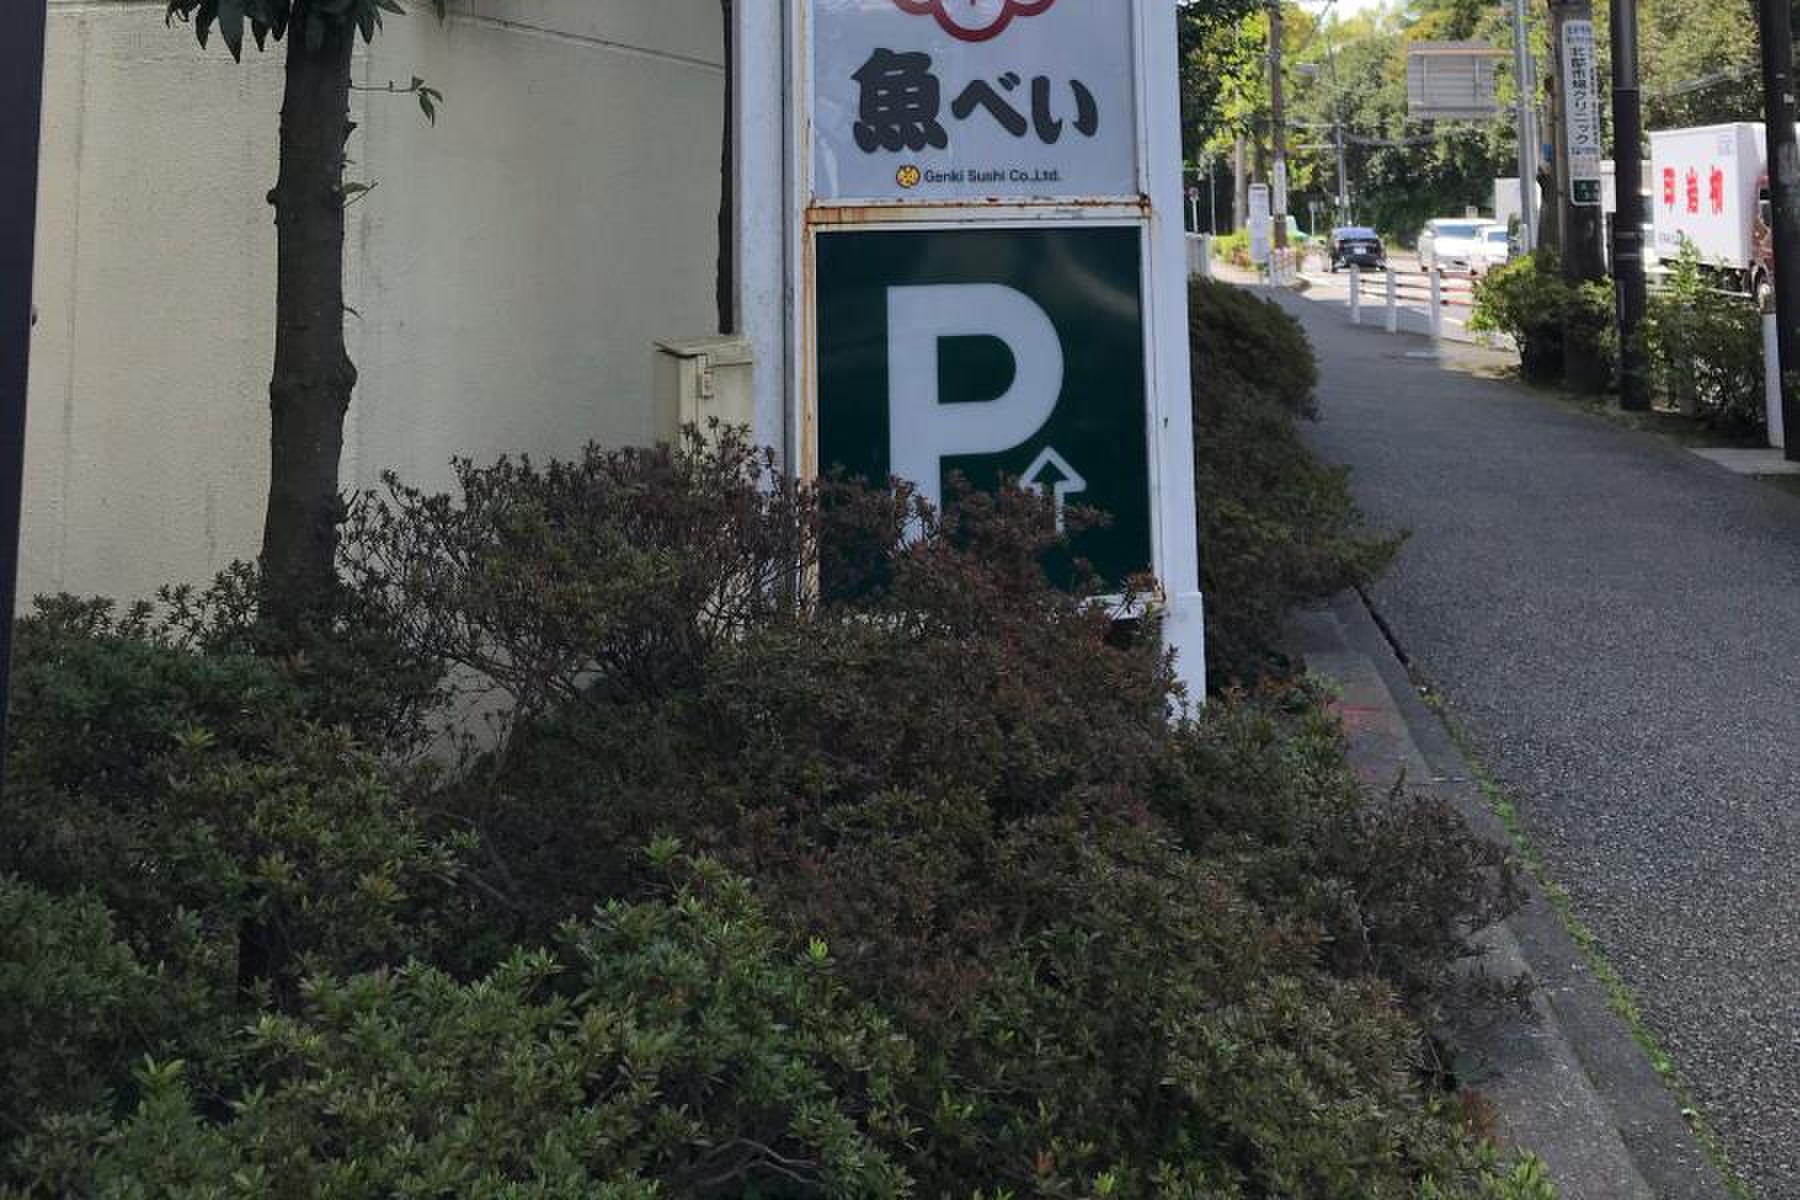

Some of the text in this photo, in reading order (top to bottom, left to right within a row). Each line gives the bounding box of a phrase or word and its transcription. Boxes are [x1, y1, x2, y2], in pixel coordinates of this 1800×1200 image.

[851, 47, 1099, 154] 魚べい
[923, 168, 963, 184] Genki
[967, 168, 1005, 183] Sushi
[887, 282, 1064, 552] P
